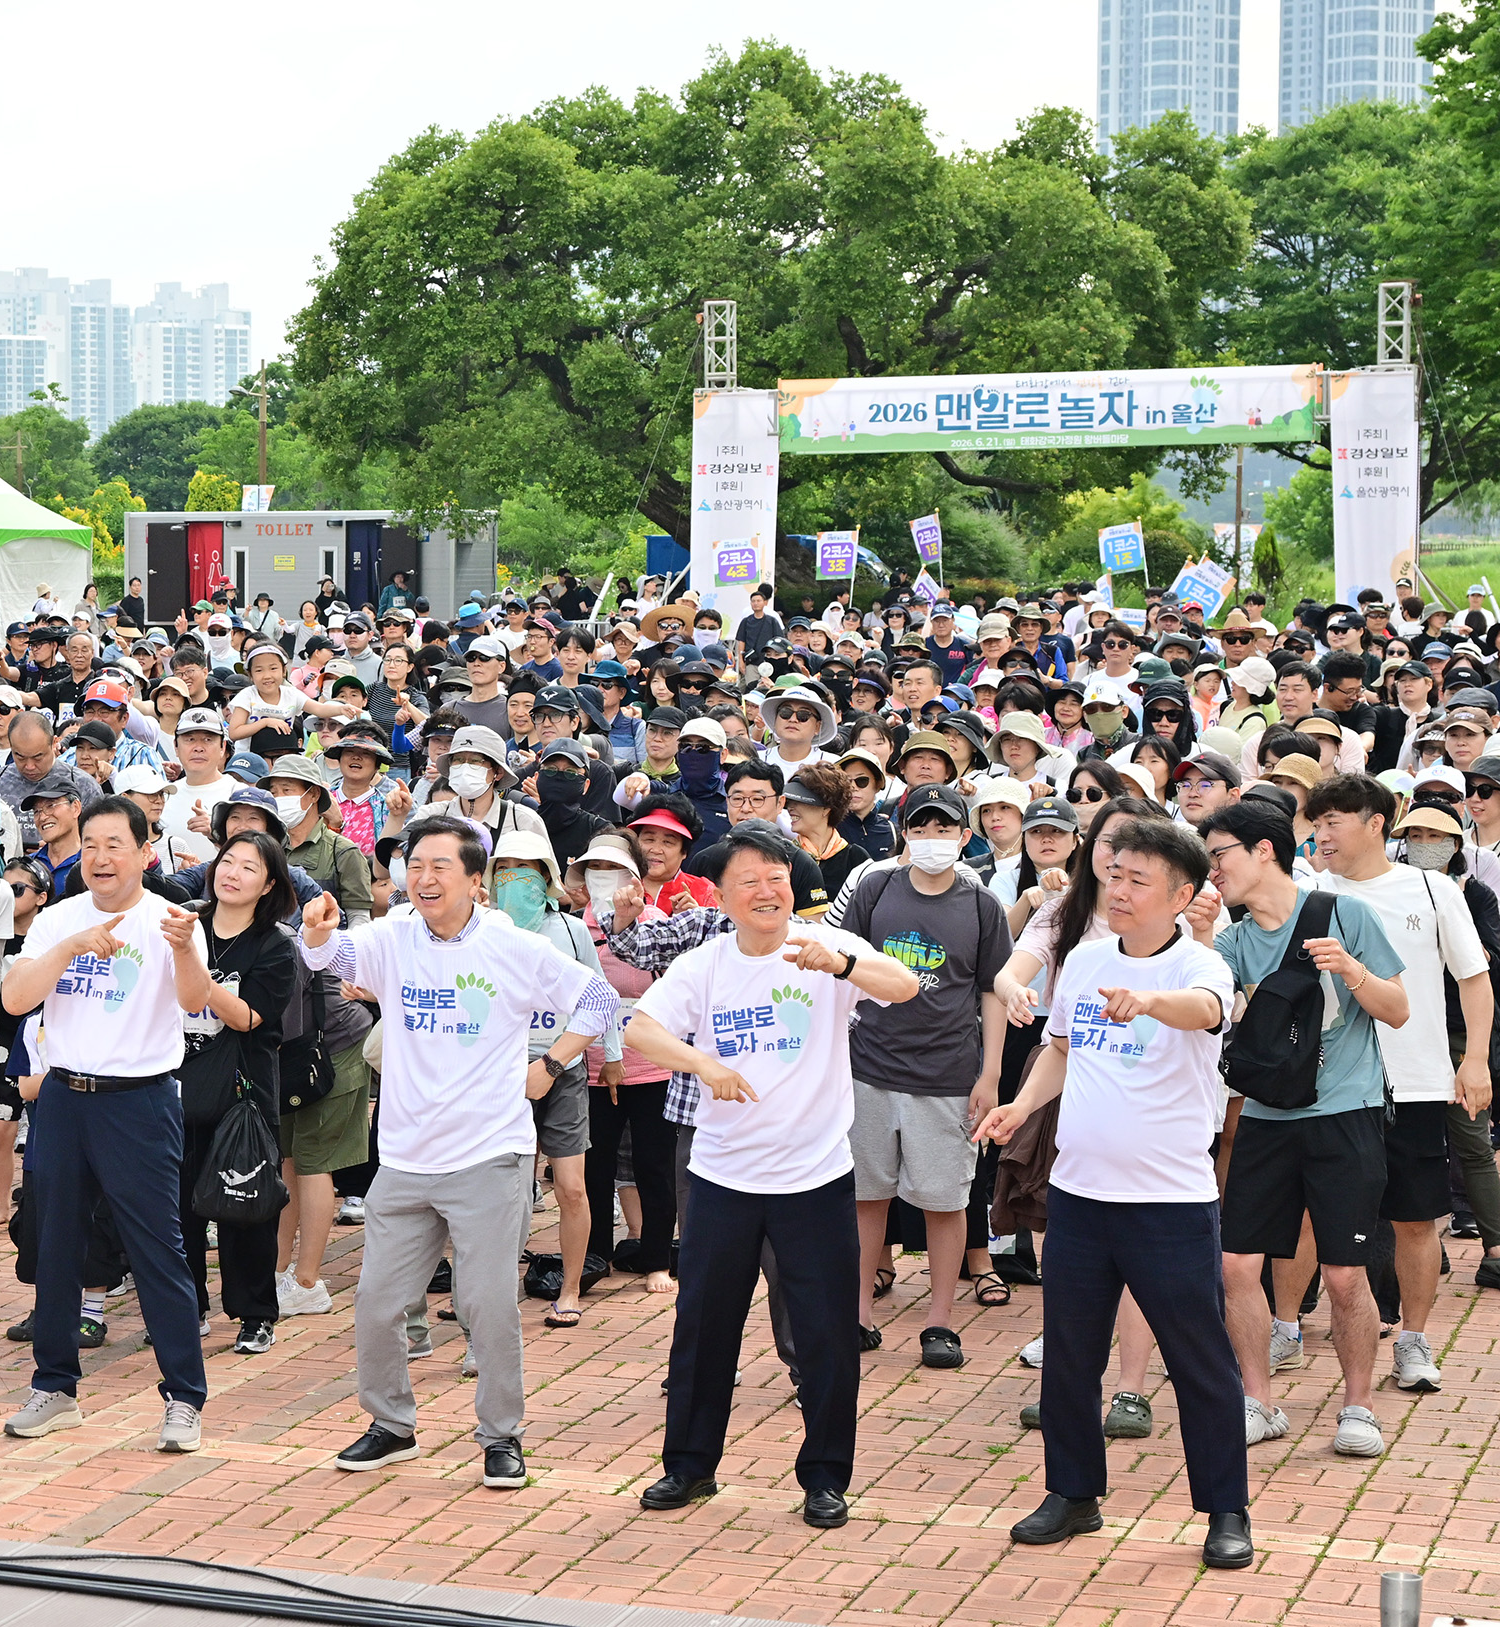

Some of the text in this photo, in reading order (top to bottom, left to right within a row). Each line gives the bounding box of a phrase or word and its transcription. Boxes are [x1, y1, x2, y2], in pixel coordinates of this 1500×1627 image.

[868, 402, 928, 423] 2026
[1057, 389, 1139, 429] 놀자
[1146, 405, 1166, 424] in
[1171, 402, 1218, 425] 울산
[1020, 434, 1083, 447] 태화강국가정원
[1084, 433, 1129, 446] 왕버들마당
[1363, 428, 1382, 439] 주최
[721, 445, 739, 455] 주최
[1350, 447, 1408, 459] 경상일보
[709, 462, 763, 475] 경상일보
[1364, 466, 1382, 477] 후원
[720, 481, 739, 491] 후원
[1356, 485, 1410, 499] 울산광역시
[713, 498, 763, 511] 울산광역시
[255, 523, 314, 536] TOILET
[917, 528, 939, 545] 2코스
[822, 545, 852, 559] 2코스
[925, 542, 939, 556] 1조
[1106, 537, 1138, 553] 1코스
[719, 551, 754, 566] 2코스
[827, 559, 846, 572] 3조
[1114, 551, 1134, 566] 1조
[726, 565, 749, 579] 4조
[1181, 578, 1216, 608] 1코스
[928, 790, 939, 799] NY
[1406, 913, 1421, 931] NY
[55, 976, 126, 1002] 놀자 in 울산
[401, 985, 456, 1009] 맨발로
[403, 1009, 480, 1035] 놀자 in 울산
[712, 1005, 776, 1035] 맨발로
[1072, 1002, 1128, 1029] 맨발
[715, 1032, 801, 1058] 놀자 in 울산
[1070, 1026, 1144, 1057] 놀자 in 울산
